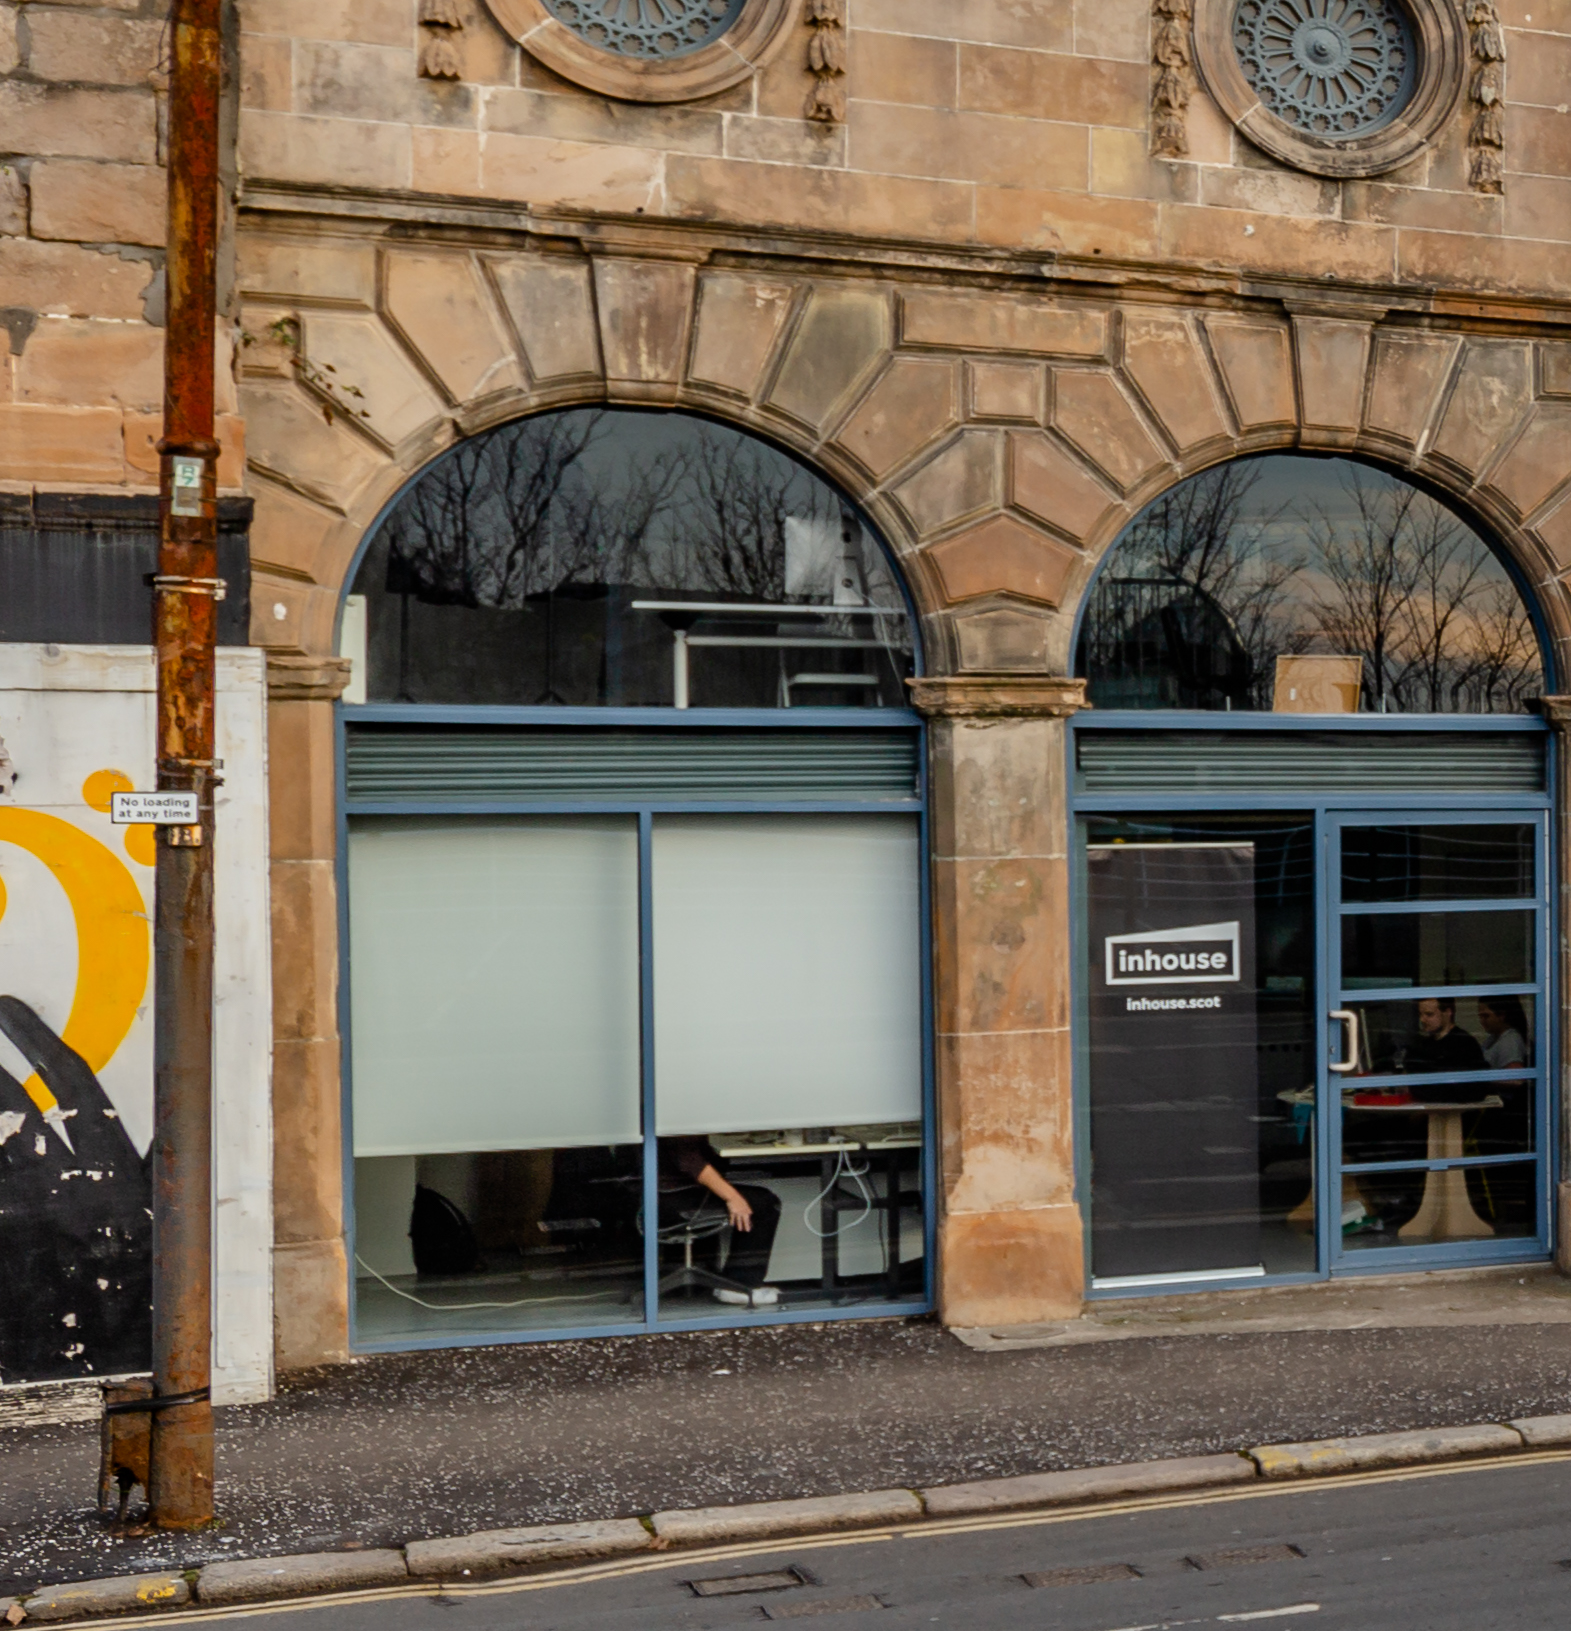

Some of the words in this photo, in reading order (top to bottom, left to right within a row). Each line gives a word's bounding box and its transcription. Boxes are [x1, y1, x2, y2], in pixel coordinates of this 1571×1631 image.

[120, 797, 139, 807] No
[143, 797, 190, 808] loading
[118, 809, 132, 818] at
[136, 810, 159, 819] any
[163, 809, 191, 818] time
[1118, 948, 1228, 972] inhouse
[1126, 995, 1222, 1012] inhouse.scot
